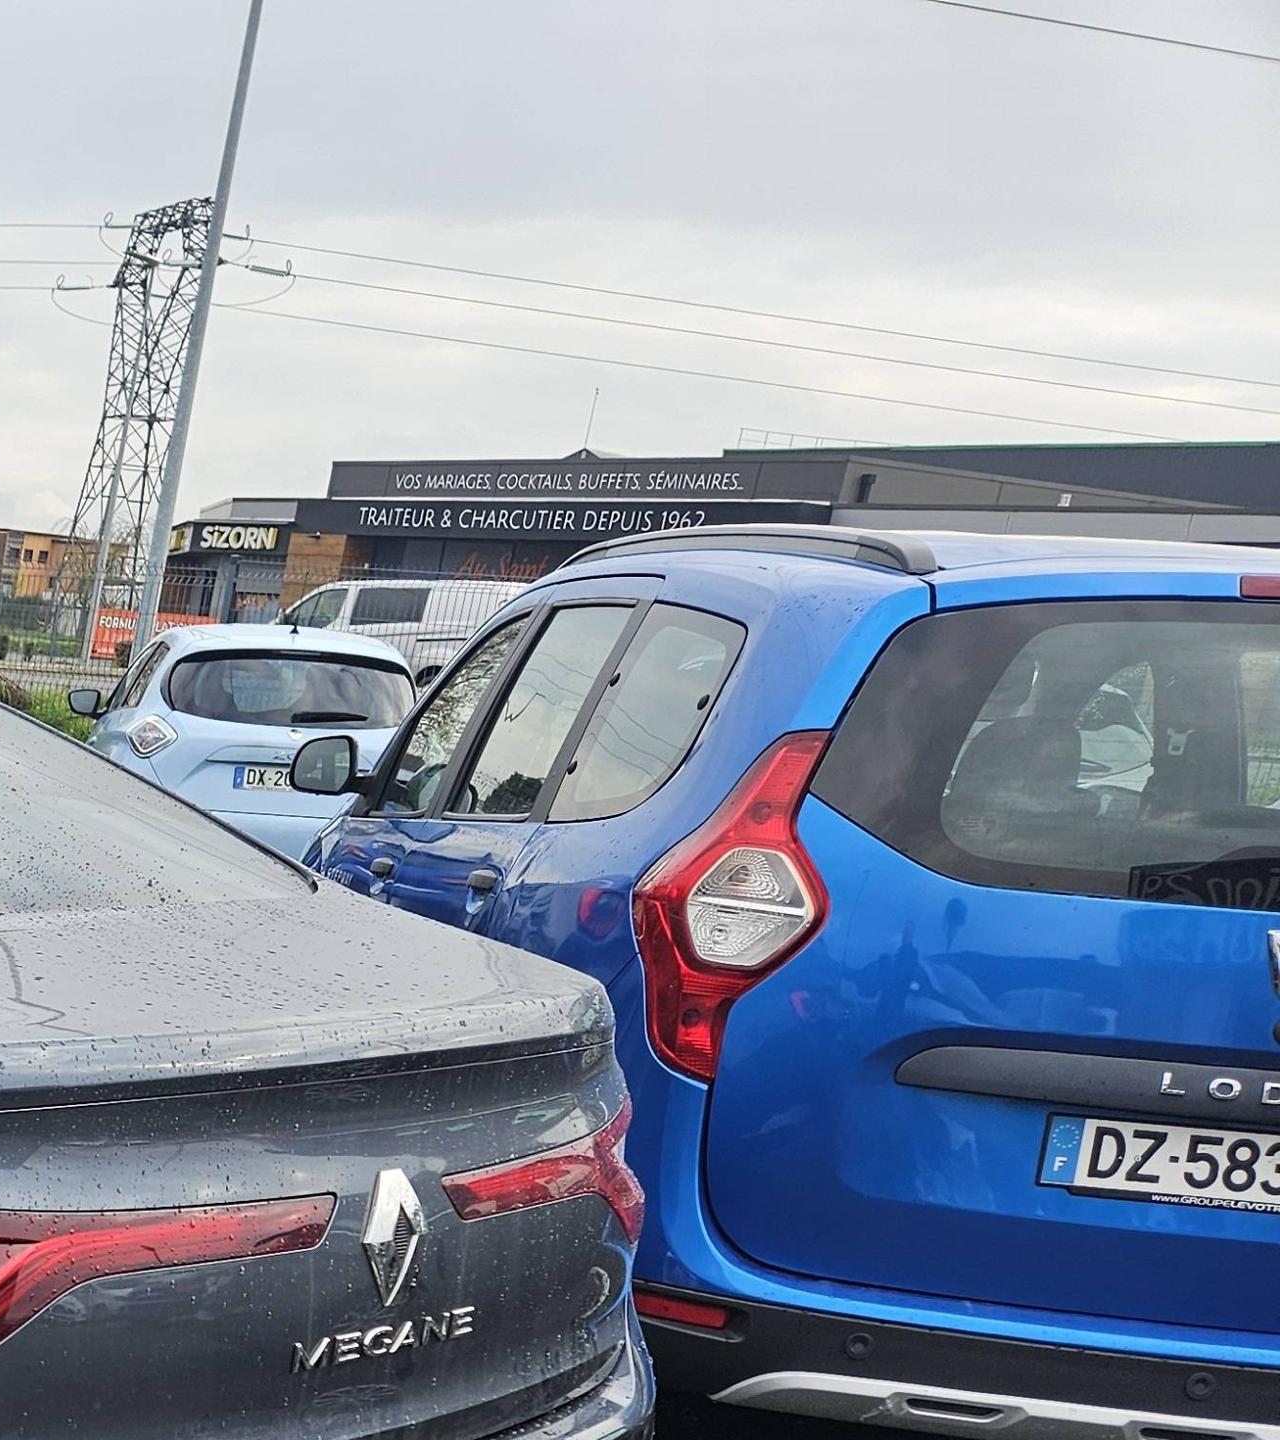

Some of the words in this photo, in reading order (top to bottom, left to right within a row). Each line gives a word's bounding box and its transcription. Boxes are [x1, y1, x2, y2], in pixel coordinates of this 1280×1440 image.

[396, 474, 421, 490] VOS
[359, 507, 435, 528] TRAITEUR
[441, 511, 451, 528] &
[458, 509, 575, 530] CHARCUTIER
[582, 510, 653, 531] DEPUIS
[660, 511, 705, 530] 1962
[1052, 1156, 1068, 1172] F
[292, 1305, 476, 1373] MEGANE
